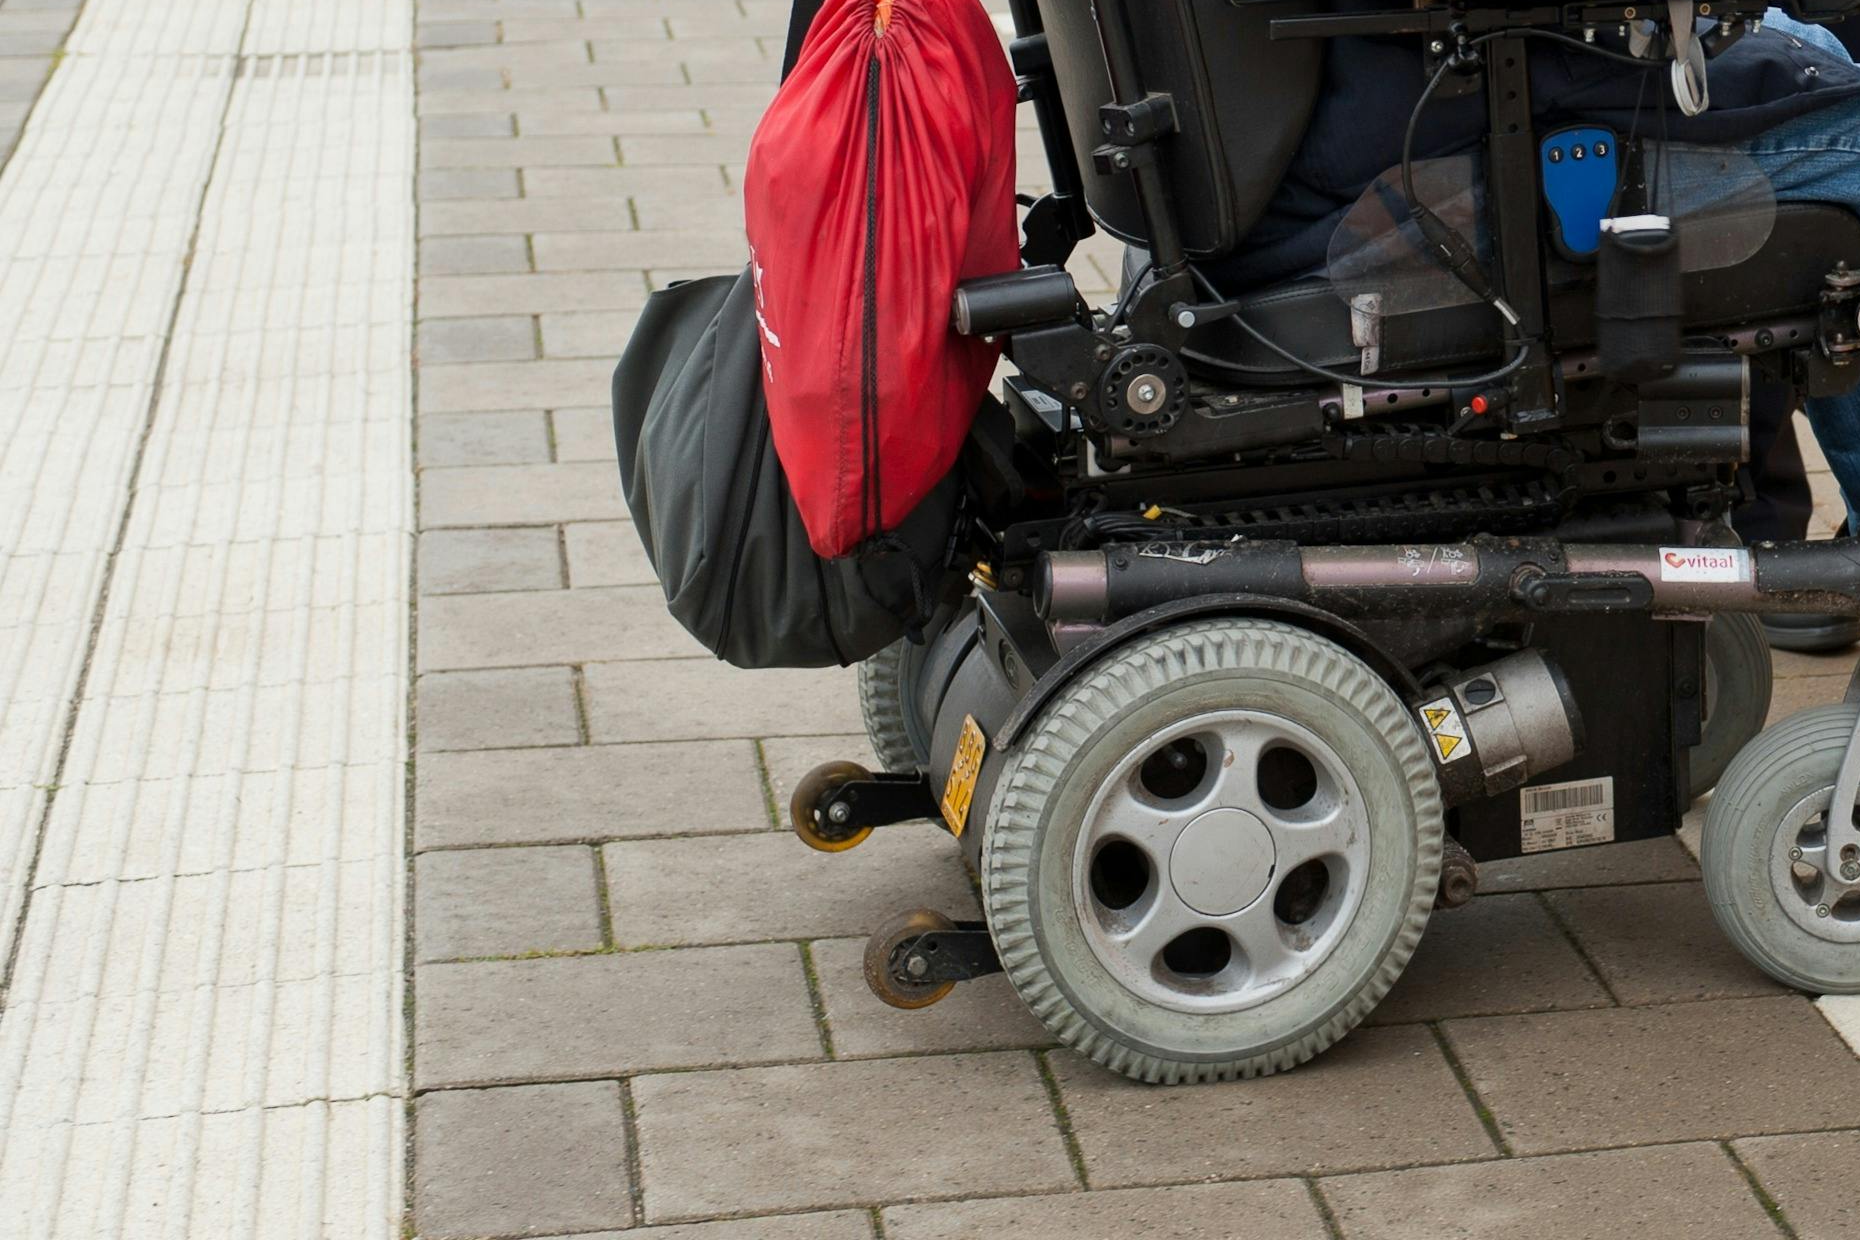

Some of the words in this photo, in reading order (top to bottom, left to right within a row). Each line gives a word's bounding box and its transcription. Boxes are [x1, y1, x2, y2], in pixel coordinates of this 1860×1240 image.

[1554, 151, 1559, 160] 1
[1575, 147, 1583, 158] 2
[1599, 144, 1606, 155] 3
[1687, 555, 1733, 568] vitaal
